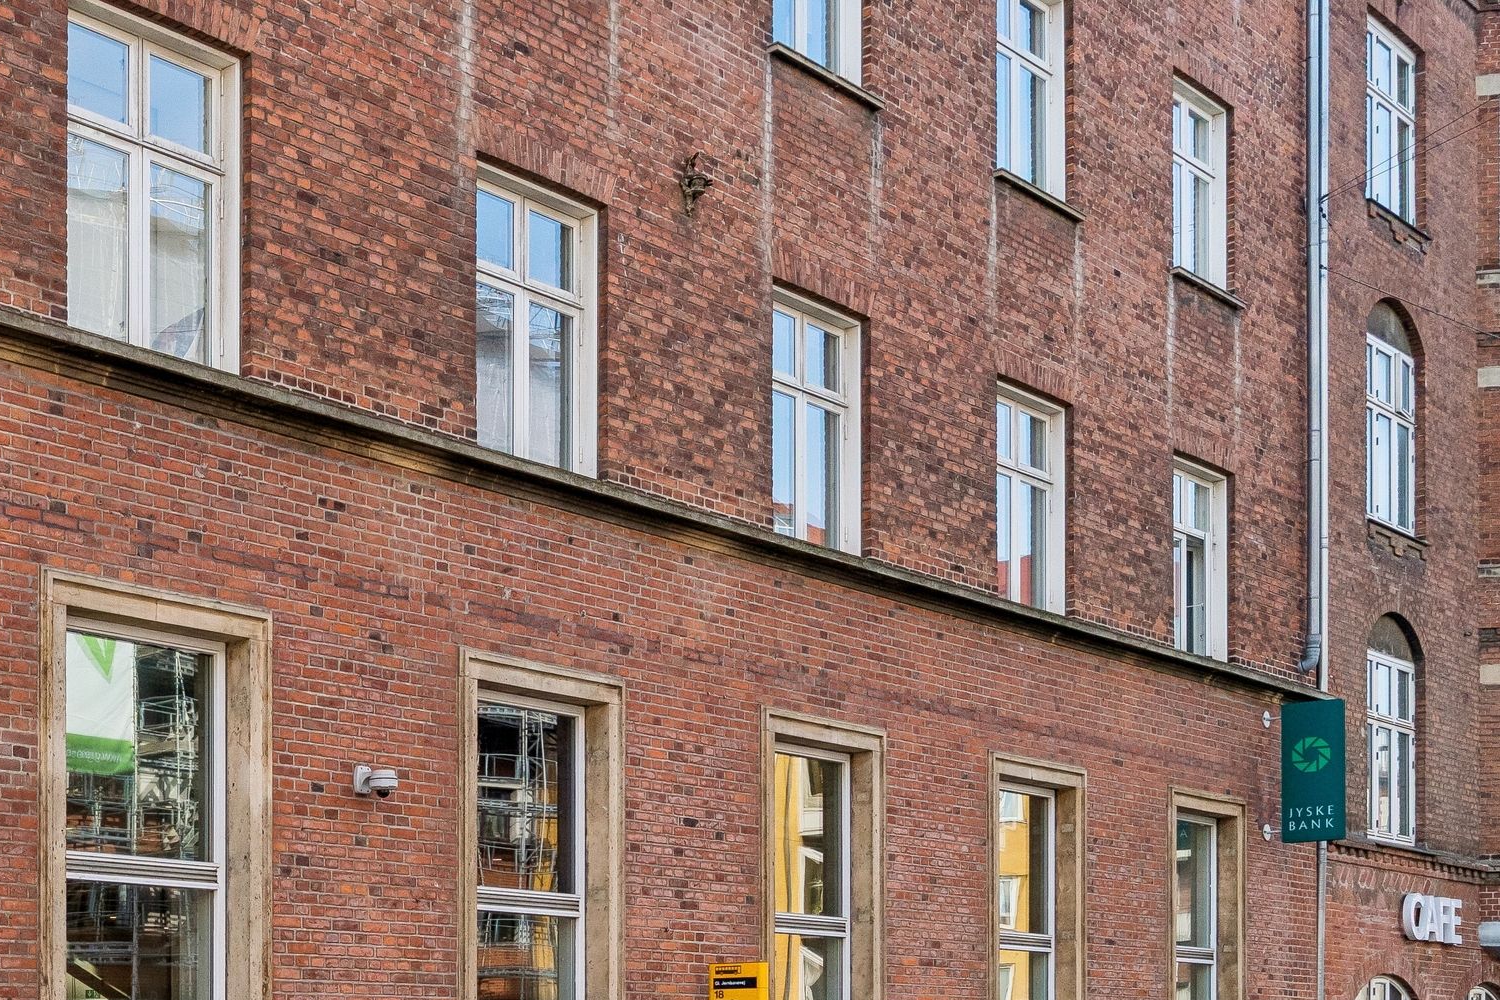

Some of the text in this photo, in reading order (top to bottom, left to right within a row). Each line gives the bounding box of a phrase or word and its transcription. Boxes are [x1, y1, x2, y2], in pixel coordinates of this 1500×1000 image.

[1289, 804, 1335, 819] JYSKE
[1289, 817, 1335, 831] BANK
[1403, 892, 1463, 946] CAFE
[714, 990, 724, 999] 18
